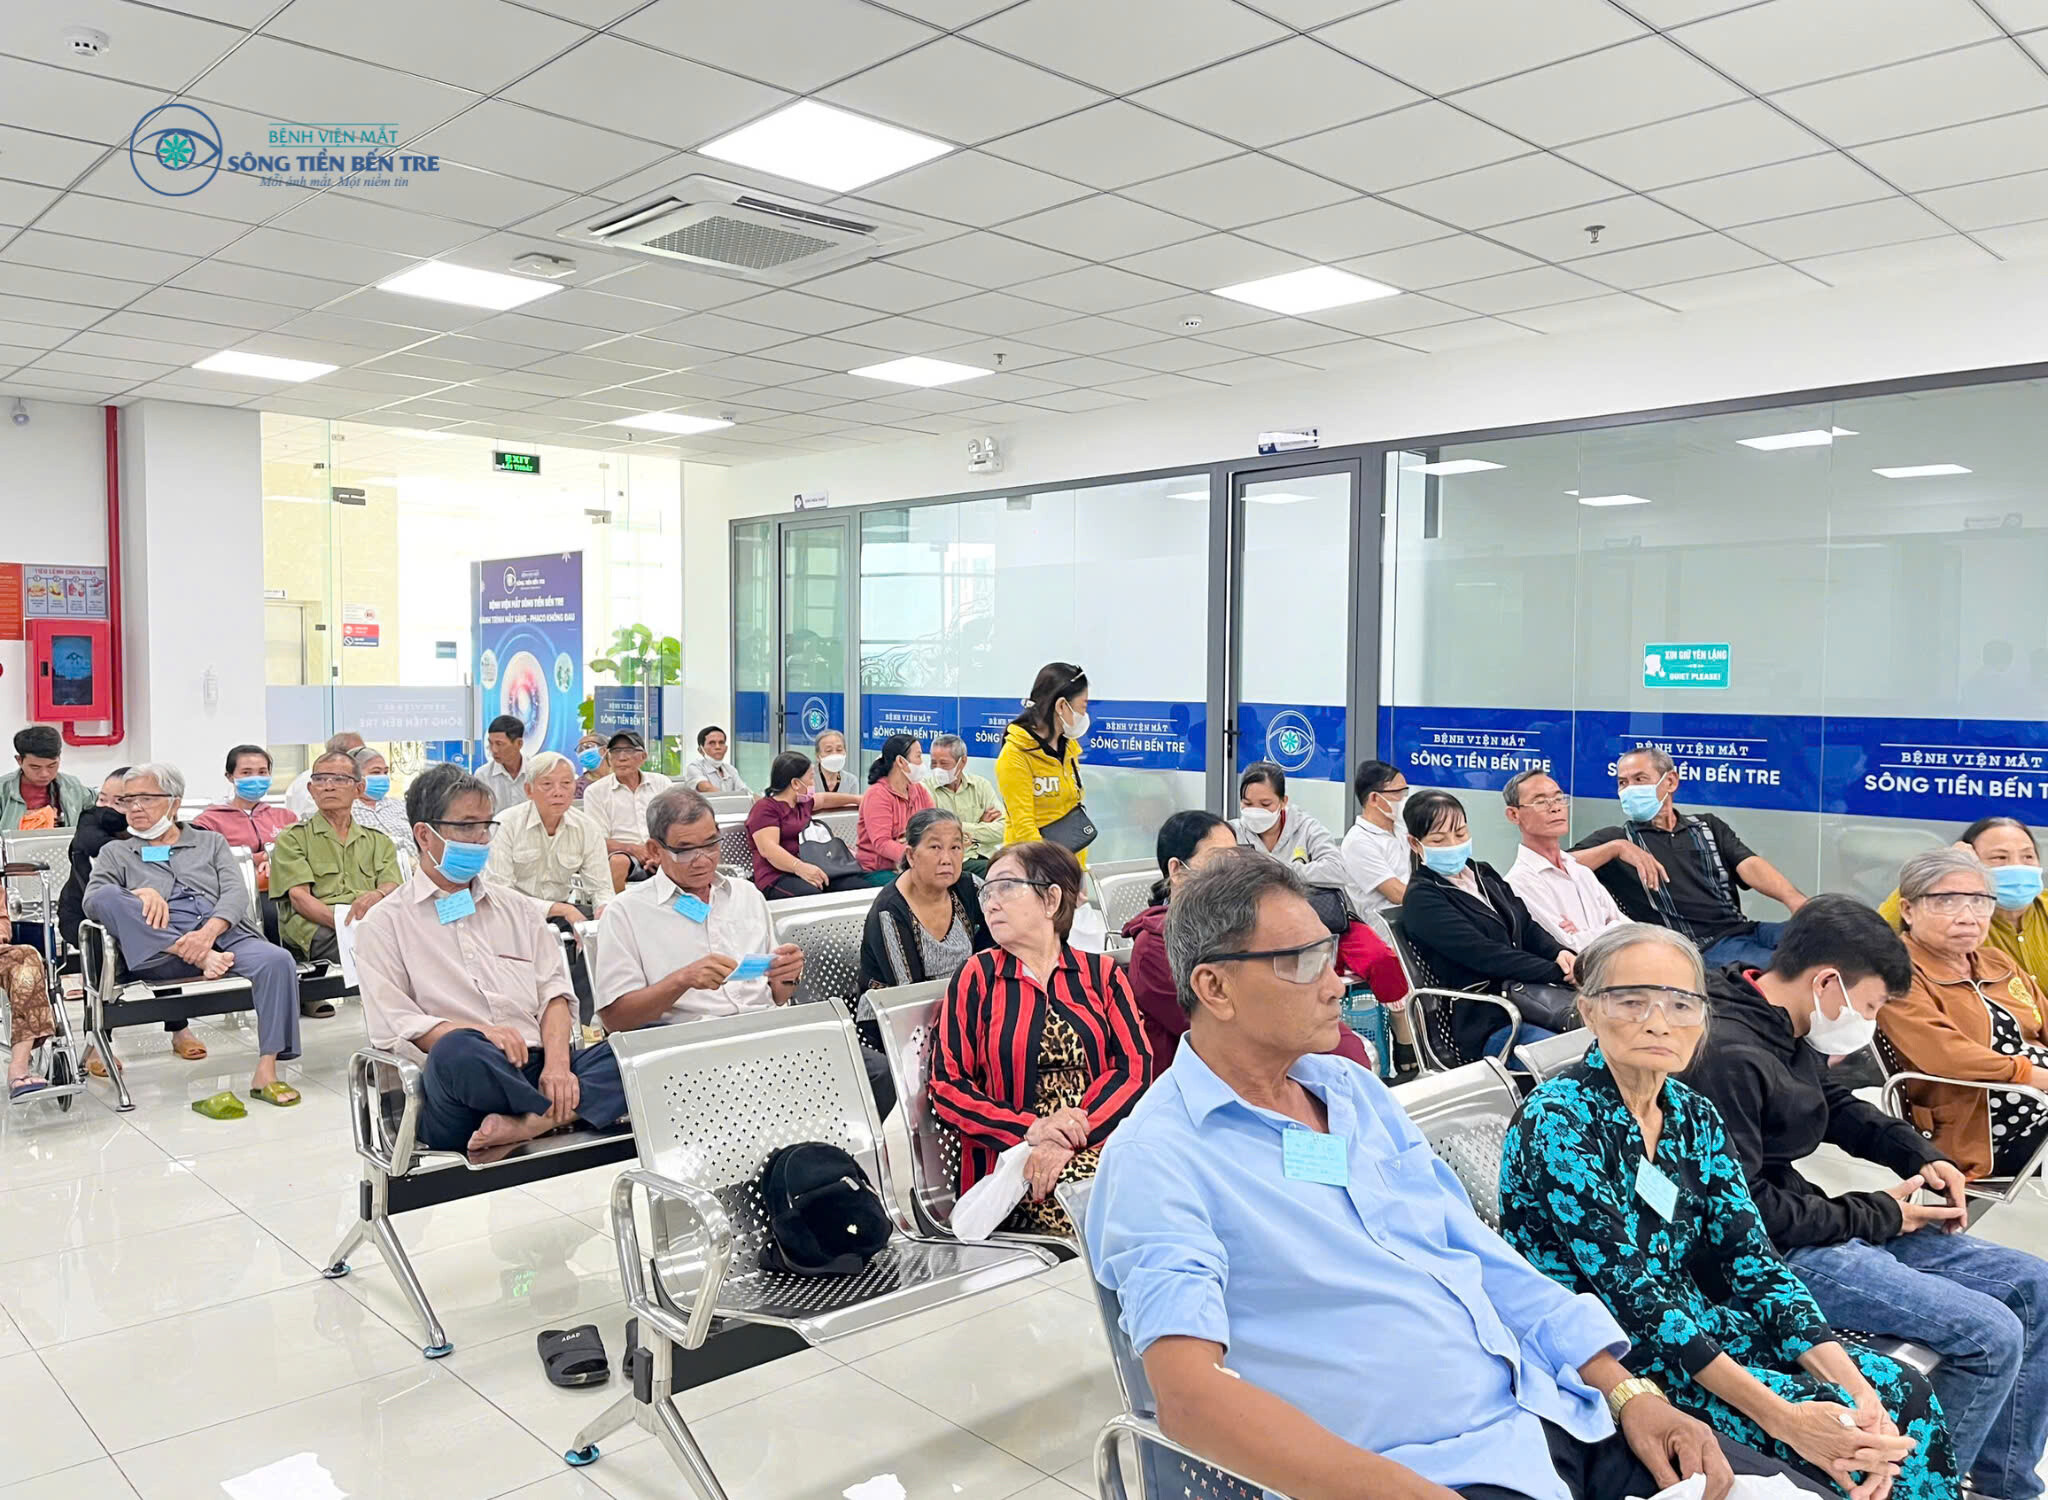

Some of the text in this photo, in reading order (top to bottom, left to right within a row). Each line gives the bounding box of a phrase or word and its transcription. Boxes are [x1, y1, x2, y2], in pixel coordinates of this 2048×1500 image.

[505, 454, 530, 465] EXIT
[1664, 650, 1678, 660] XIN
[1692, 648, 1707, 660] YÊN
[1669, 672, 1690, 680] QUIET
[873, 725, 896, 737] SÔNG
[913, 726, 928, 739] BẾN
[1106, 721, 1126, 731] BỆNH
[1128, 722, 1150, 732] VIỆN
[975, 730, 1000, 743] SÔNG
[1090, 735, 1185, 753] SÔNG TIỀN BẾN TRE
[1434, 732, 1526, 747] BỆNH VIỆN MẮT
[1677, 741, 1715, 756] VIỆN
[1718, 742, 1749, 756] MẮT
[1410, 750, 1551, 773] SÔNG TIỀN BẾN TRE
[1901, 750, 2043, 768] BỆNH VIỆN MẮT
[1705, 763, 1741, 784] BẾN
[1745, 769, 1781, 785] TRE
[1864, 771, 1930, 793] SÔNG
[1934, 773, 1983, 795] TIỀN
[1989, 775, 2033, 798] BẾN
